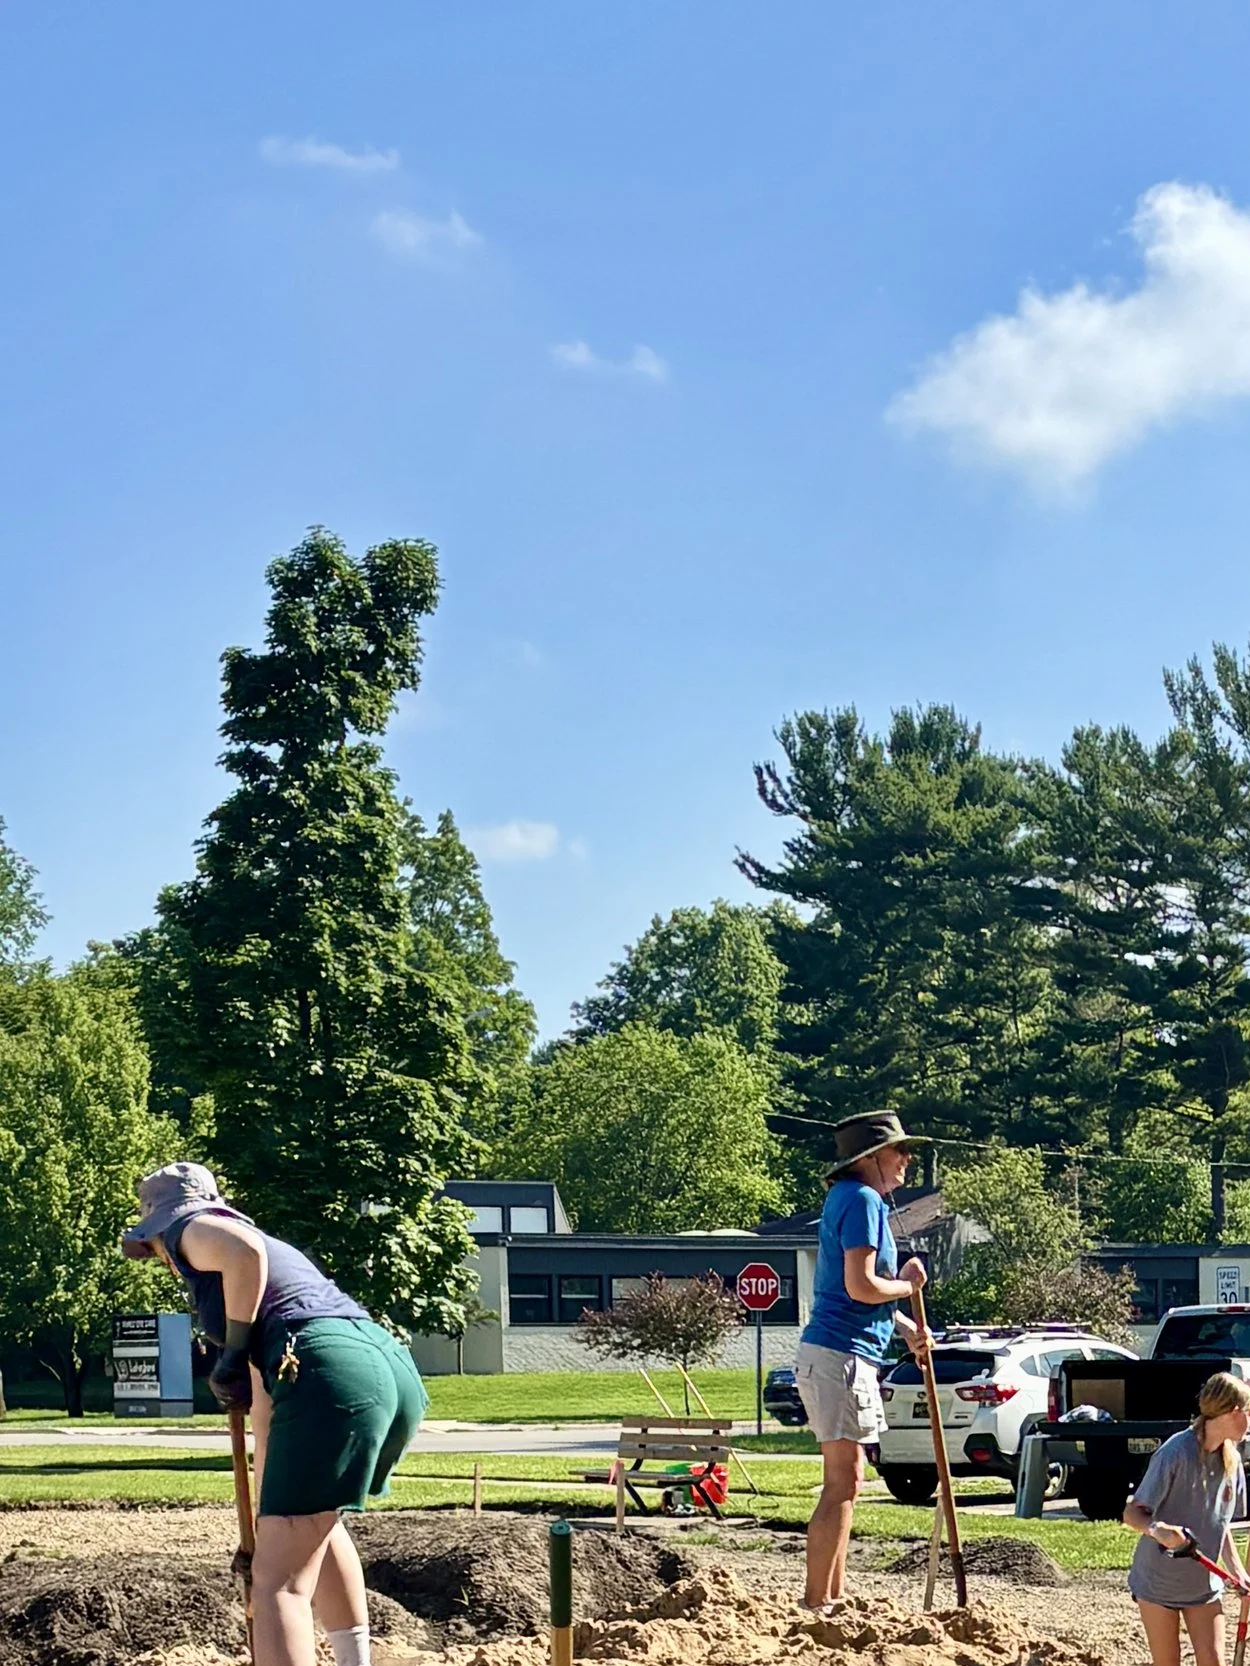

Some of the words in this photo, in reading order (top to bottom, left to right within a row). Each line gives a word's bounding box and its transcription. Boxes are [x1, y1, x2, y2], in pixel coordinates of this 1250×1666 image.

[1219, 1271, 1237, 1279] SPEED
[740, 1278, 778, 1296] STOP
[1220, 1291, 1238, 1304] 30
